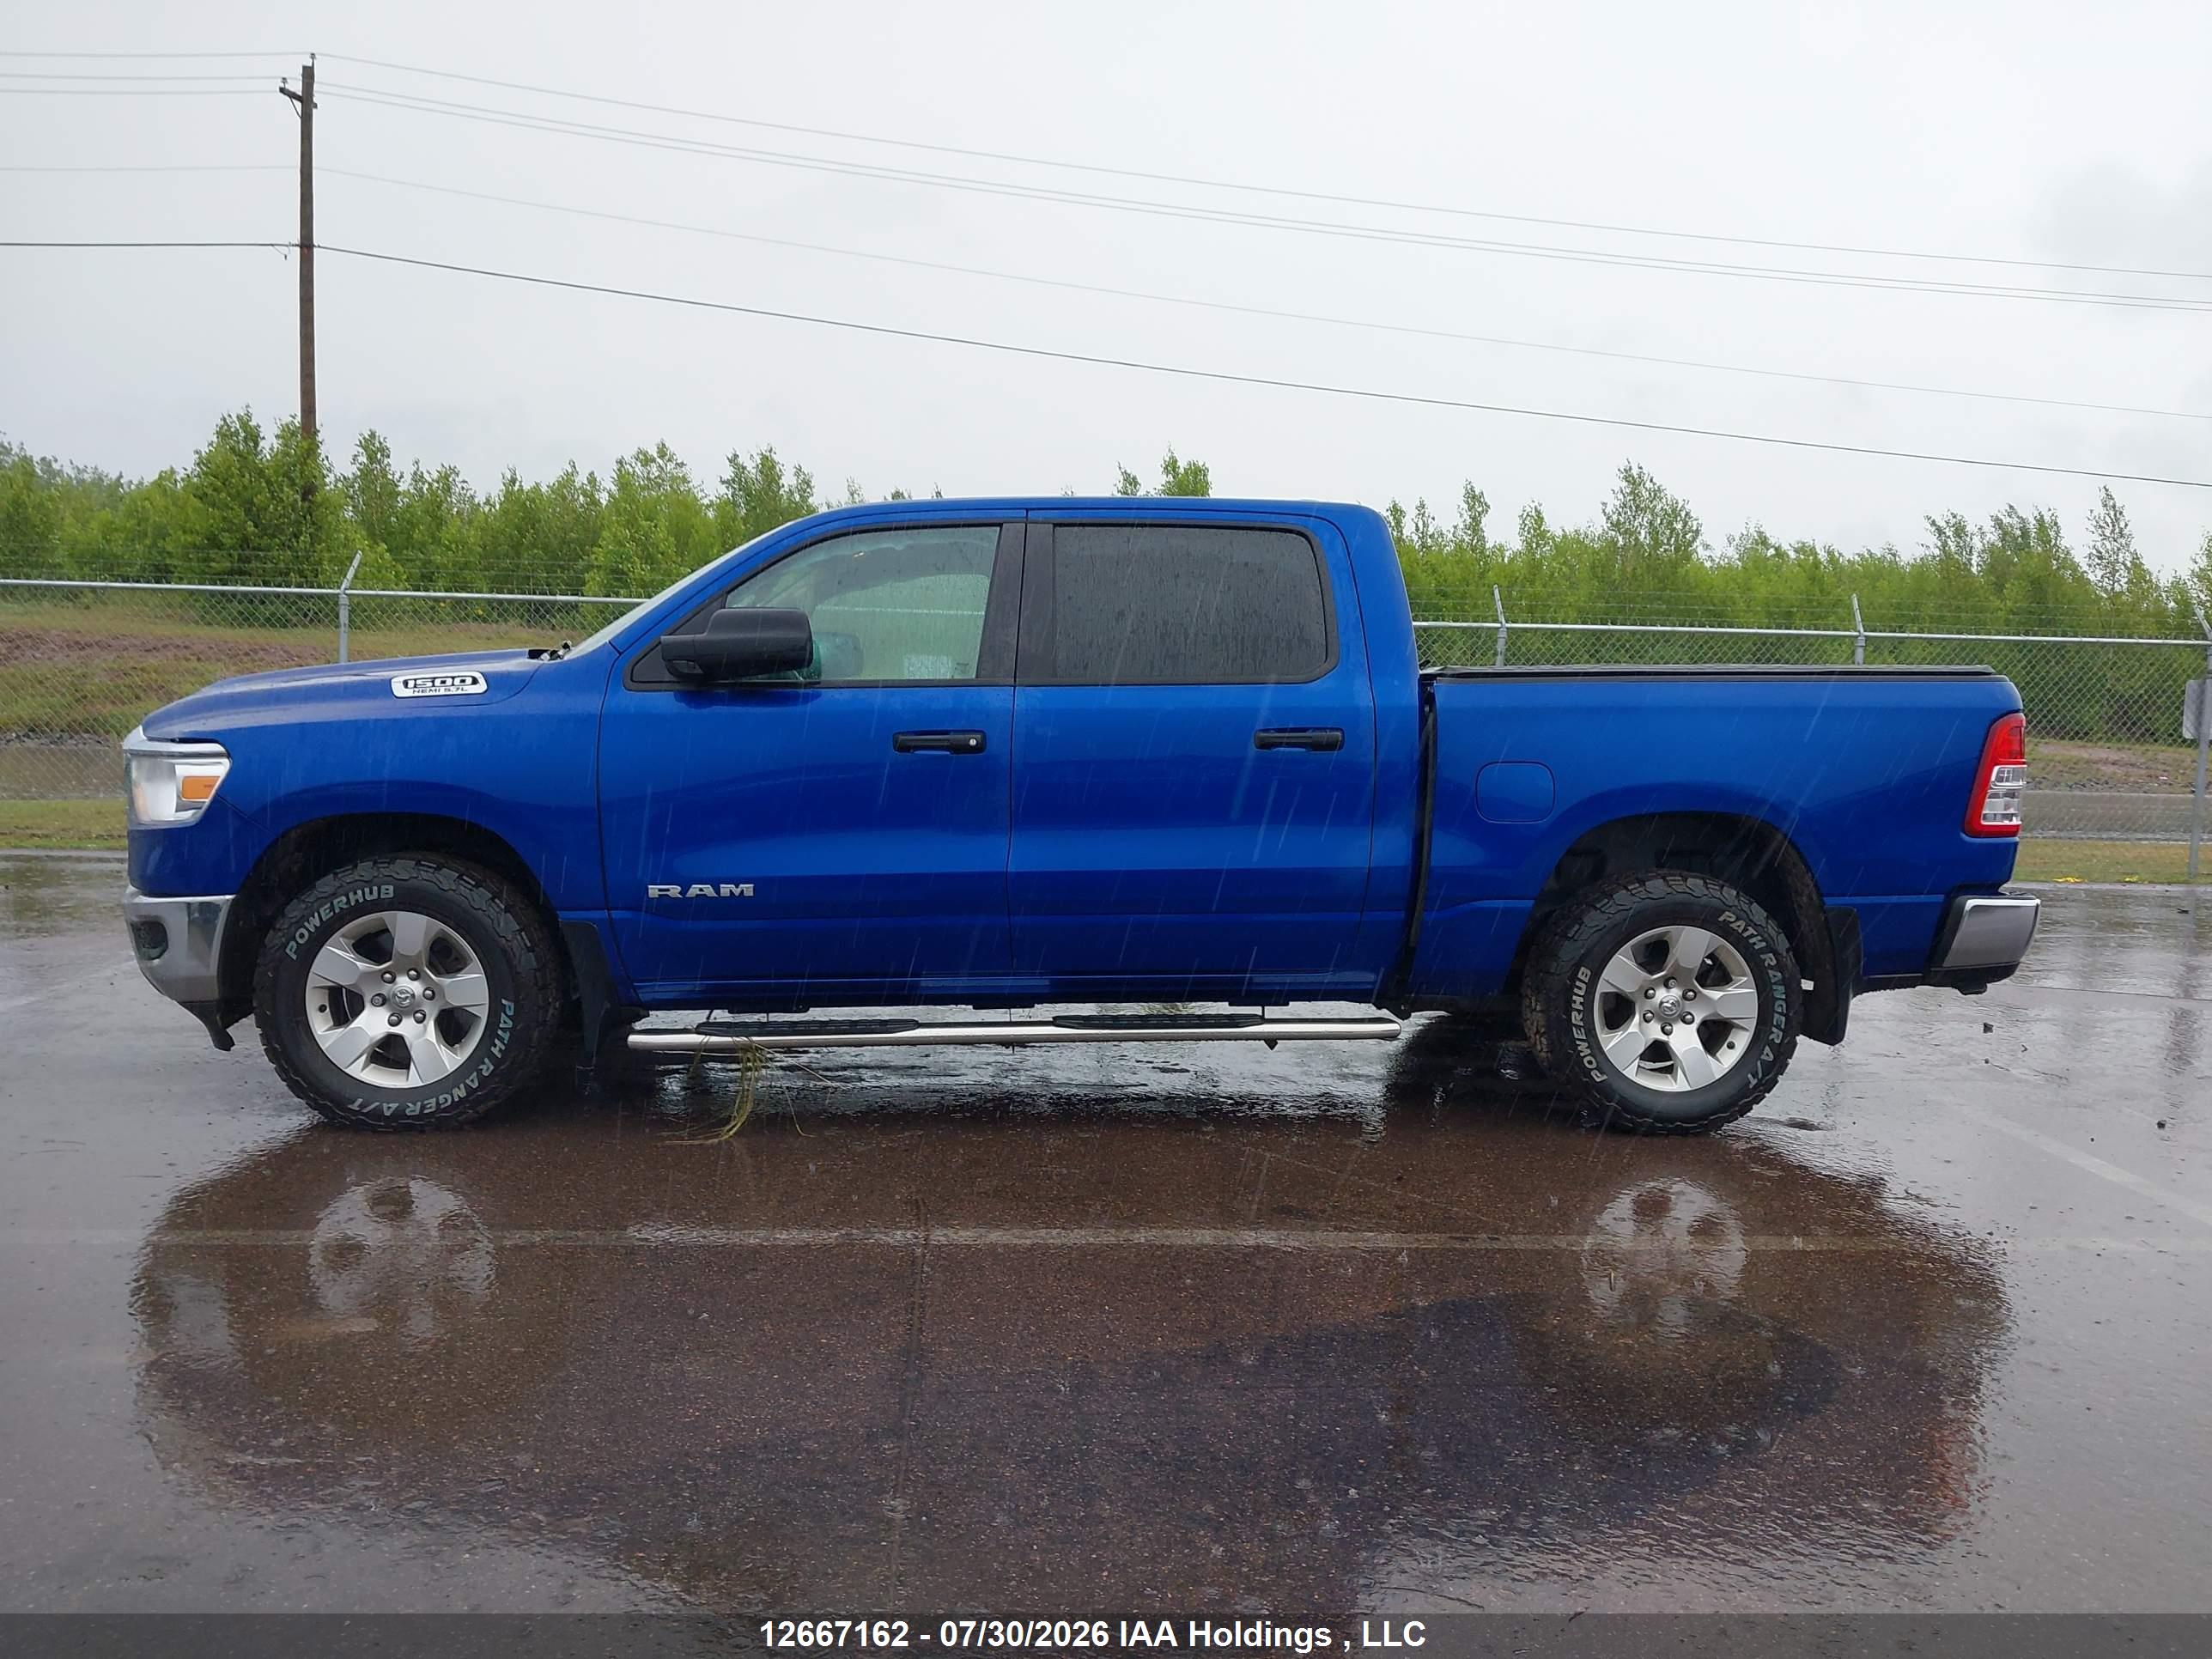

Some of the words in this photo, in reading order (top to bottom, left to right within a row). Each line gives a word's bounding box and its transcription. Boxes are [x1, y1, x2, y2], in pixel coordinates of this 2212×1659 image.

[407, 677, 473, 688] 1500
[647, 883, 755, 898] RAM
[284, 884, 395, 961] POWERHUB
[1718, 910, 1767, 951] PATH
[1759, 951, 1787, 1043] RANGER
[489, 998, 515, 1060] PATH
[1570, 966, 1608, 1084] POWERHUB
[405, 1057, 495, 1116] RANGER
[1747, 1044, 1774, 1088] A/T
[349, 1097, 399, 1116] A/T
